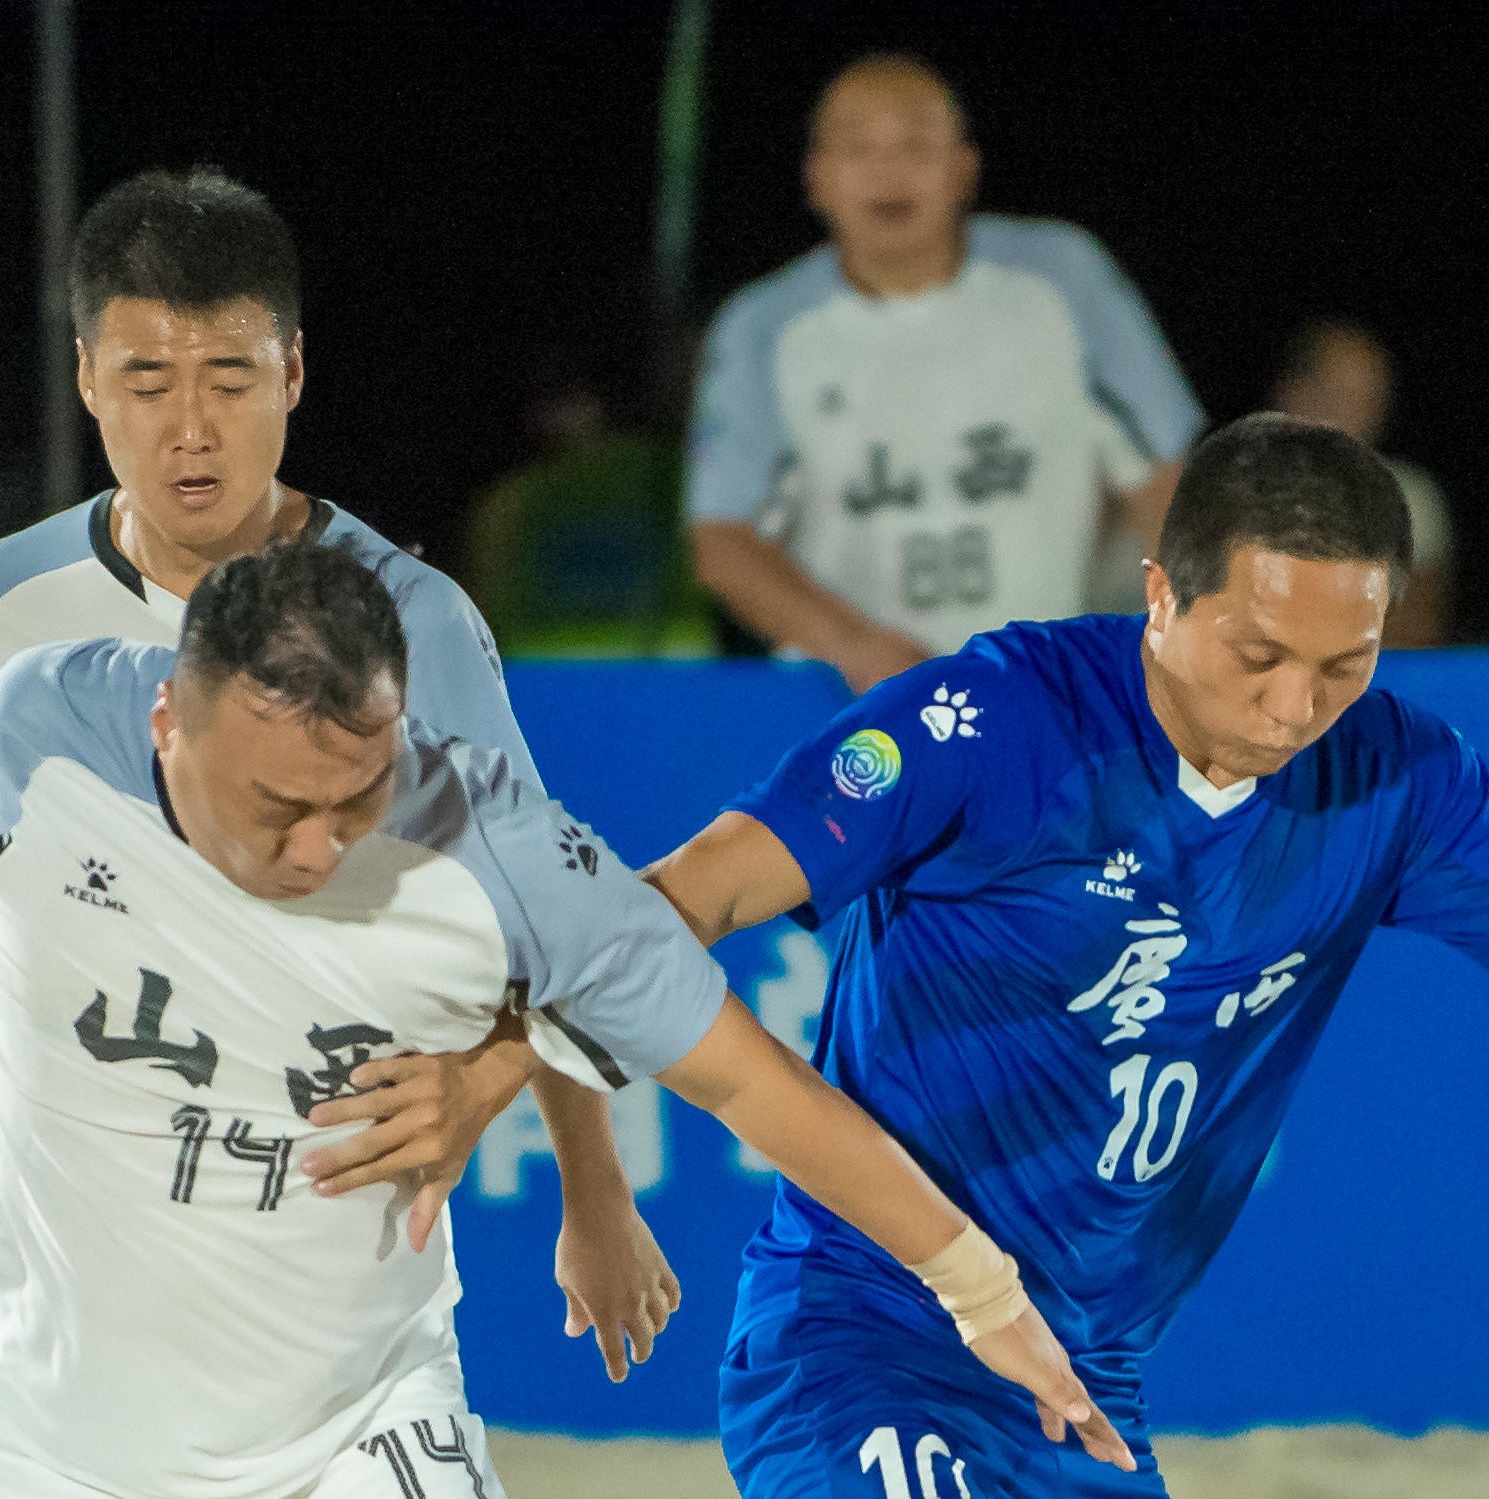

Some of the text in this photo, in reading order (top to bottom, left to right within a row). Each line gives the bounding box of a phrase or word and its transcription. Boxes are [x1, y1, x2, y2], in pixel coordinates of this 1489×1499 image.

[63, 883, 130, 916] KELME
[1086, 879, 1136, 902] KELME
[1097, 1053, 1198, 1182] 10
[171, 1104, 294, 1212] 14
